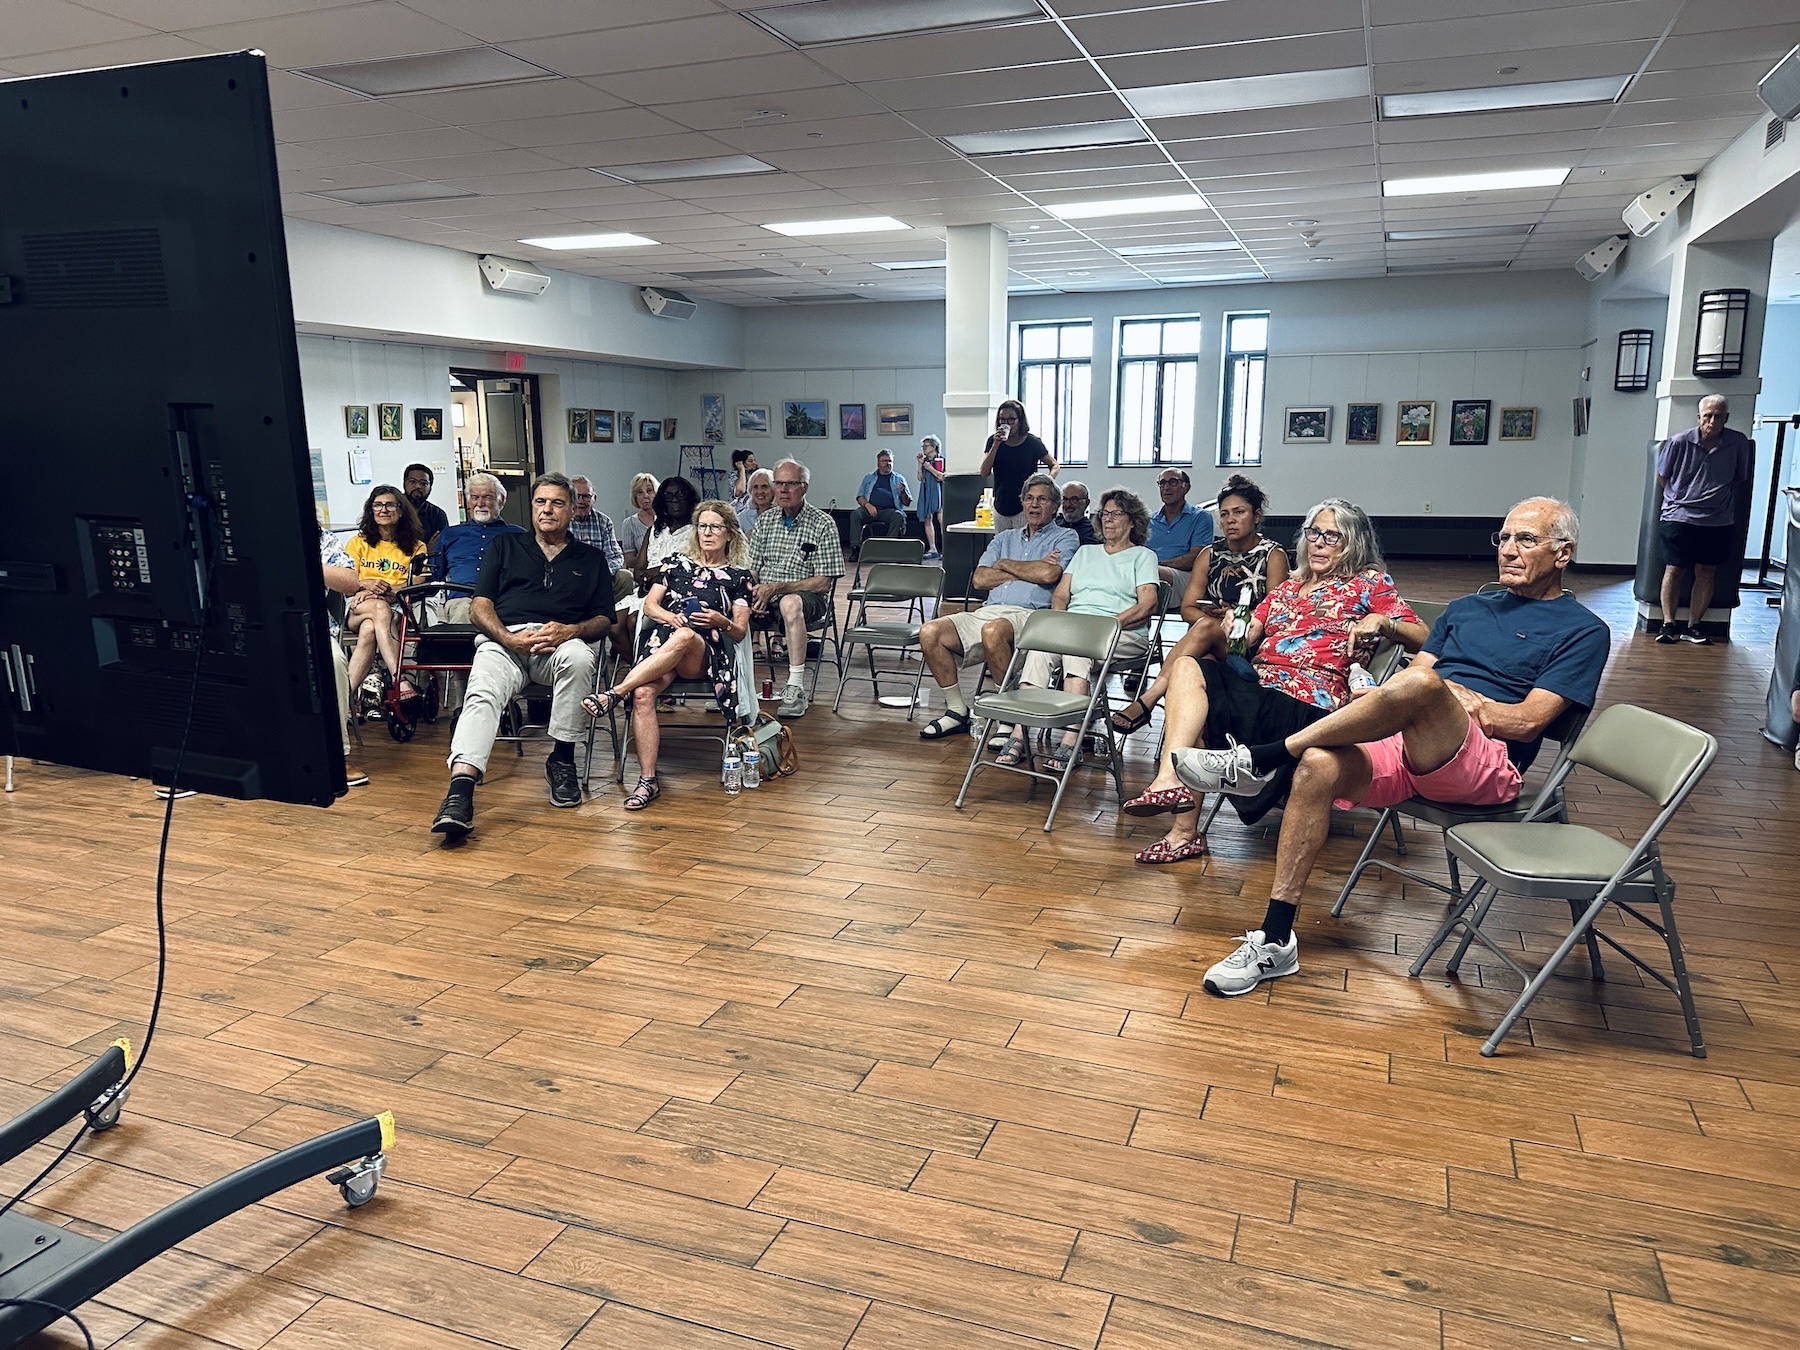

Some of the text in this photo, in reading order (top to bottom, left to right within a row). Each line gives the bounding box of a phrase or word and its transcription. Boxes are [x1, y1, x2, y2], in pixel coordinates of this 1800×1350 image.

[360, 558, 409, 574] Sun Day
[1256, 955, 1276, 975] N
